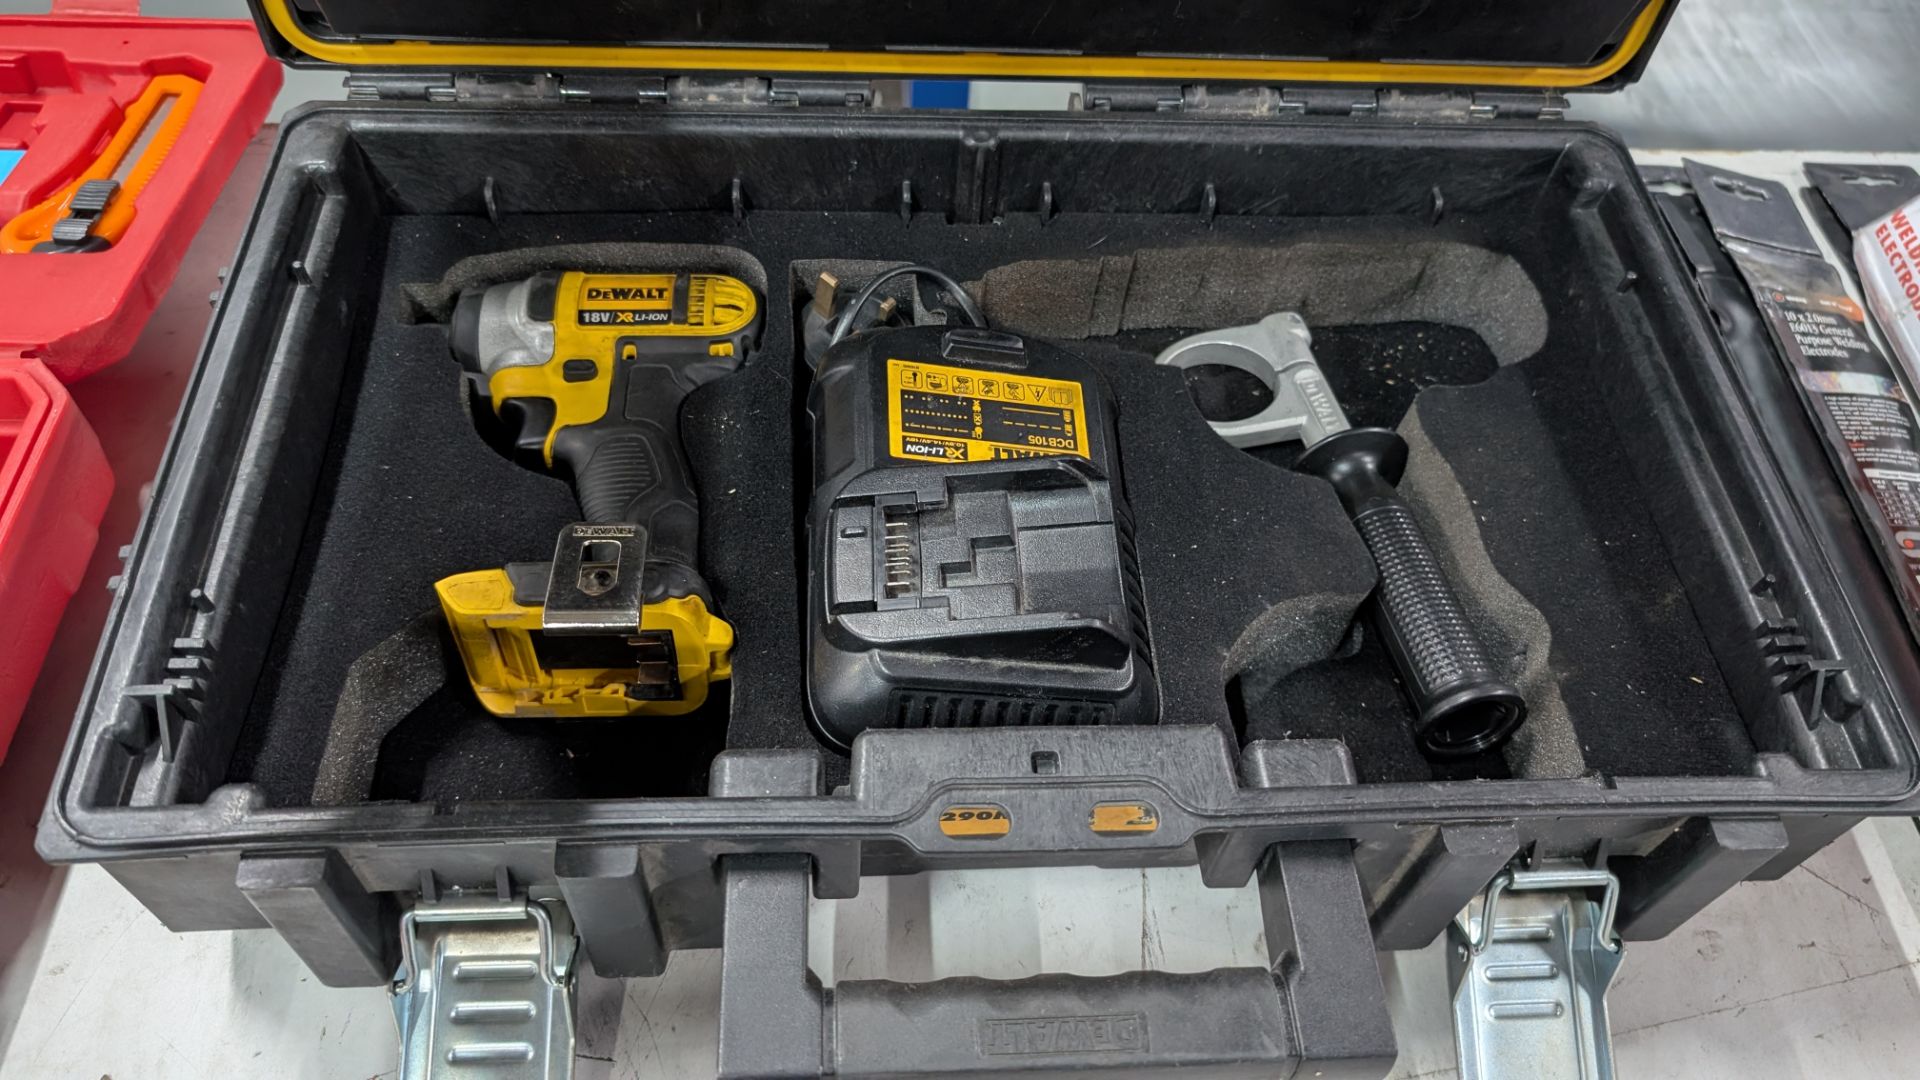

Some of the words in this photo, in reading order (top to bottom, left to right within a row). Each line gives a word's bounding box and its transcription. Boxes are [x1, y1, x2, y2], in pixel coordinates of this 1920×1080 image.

[1875, 223, 1920, 320] ELECTROD
[587, 288, 668, 300] DEWALT
[635, 313, 668, 321] LI-ION
[1785, 311, 1797, 321] 10
[1820, 325, 1854, 338] General
[1795, 334, 1833, 347] Purpose
[1832, 337, 1870, 353] Welding
[1801, 346, 1849, 358] Electrodes
[1028, 434, 1074, 449] DCB105
[906, 444, 944, 456] LI-ION
[945, 449, 966, 460] XR
